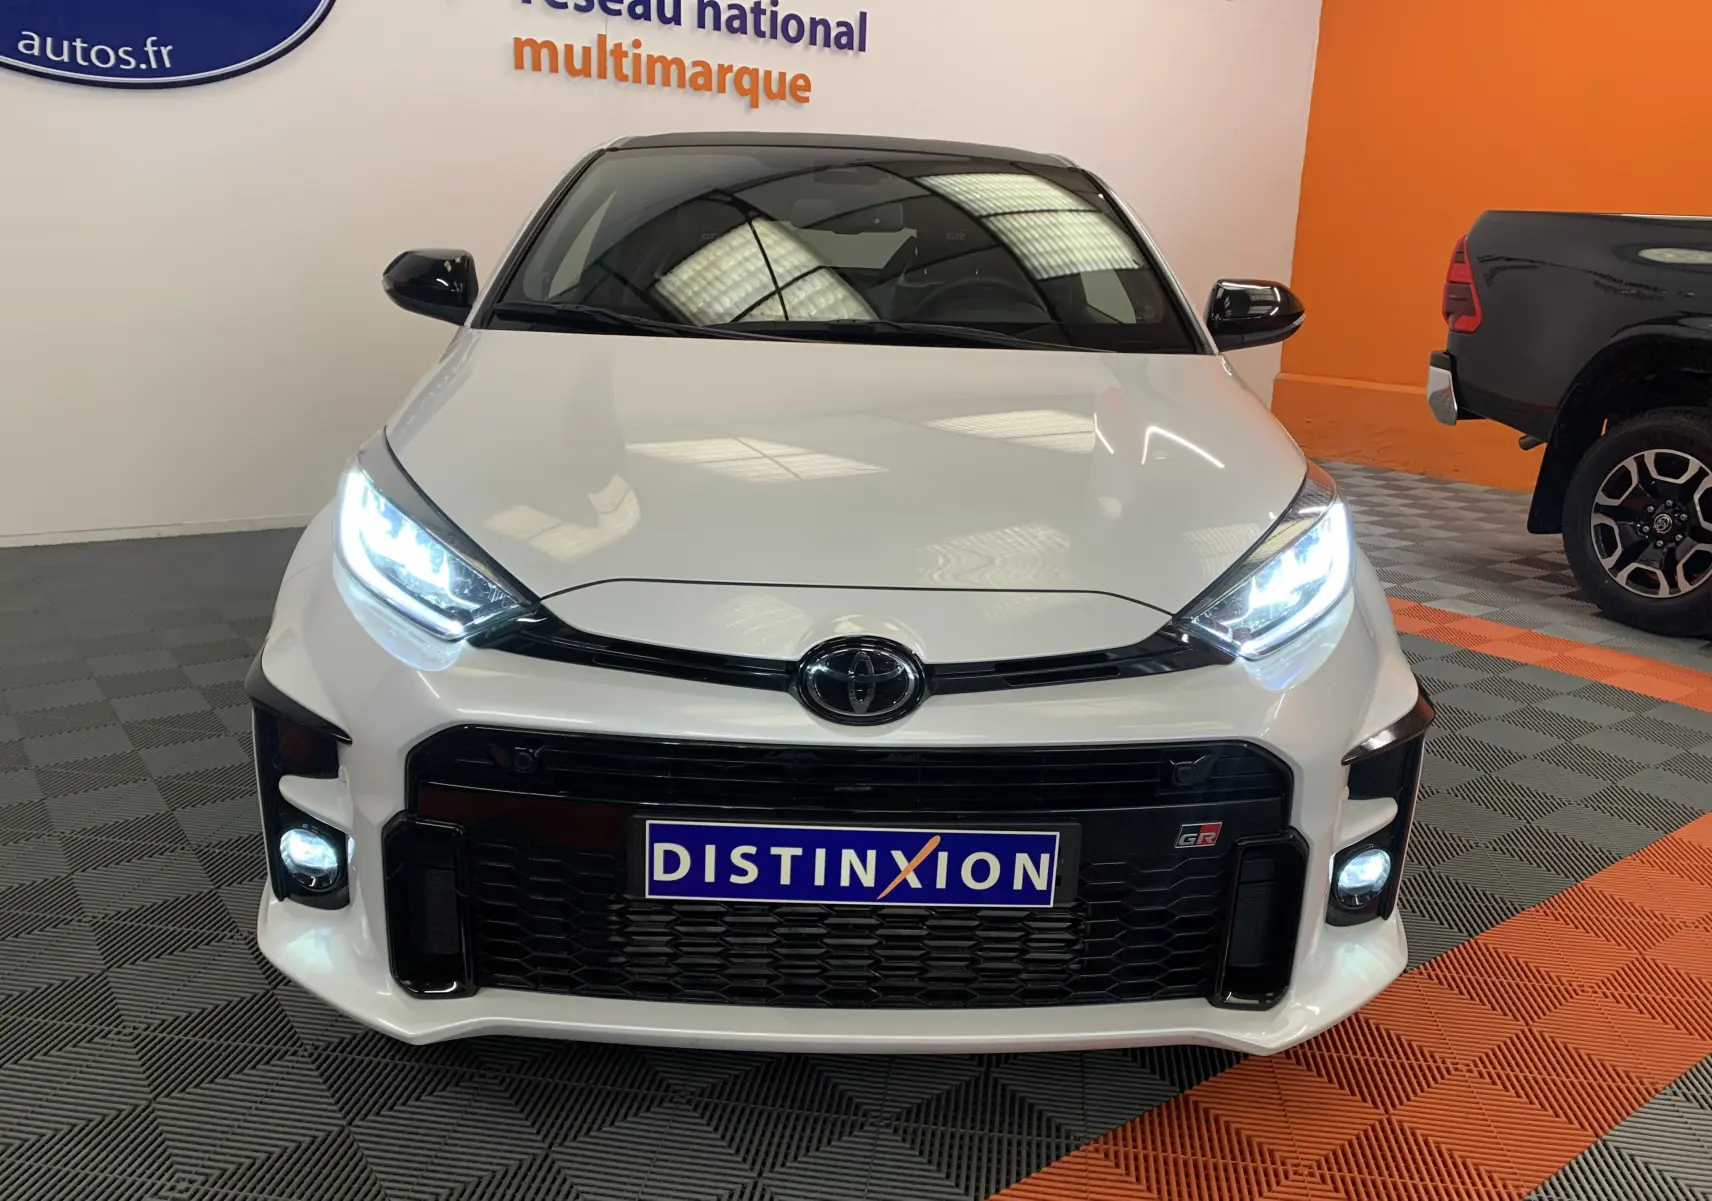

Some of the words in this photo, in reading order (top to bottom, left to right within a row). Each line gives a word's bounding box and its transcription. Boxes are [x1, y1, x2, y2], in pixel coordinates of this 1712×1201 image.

[17, 31, 173, 69] autos.fr
[521, 0, 682, 27] eau
[697, 0, 867, 52] national
[513, 33, 811, 109] multimarque
[1179, 832, 1216, 846] GR
[653, 835, 1050, 900] DISTINXION
